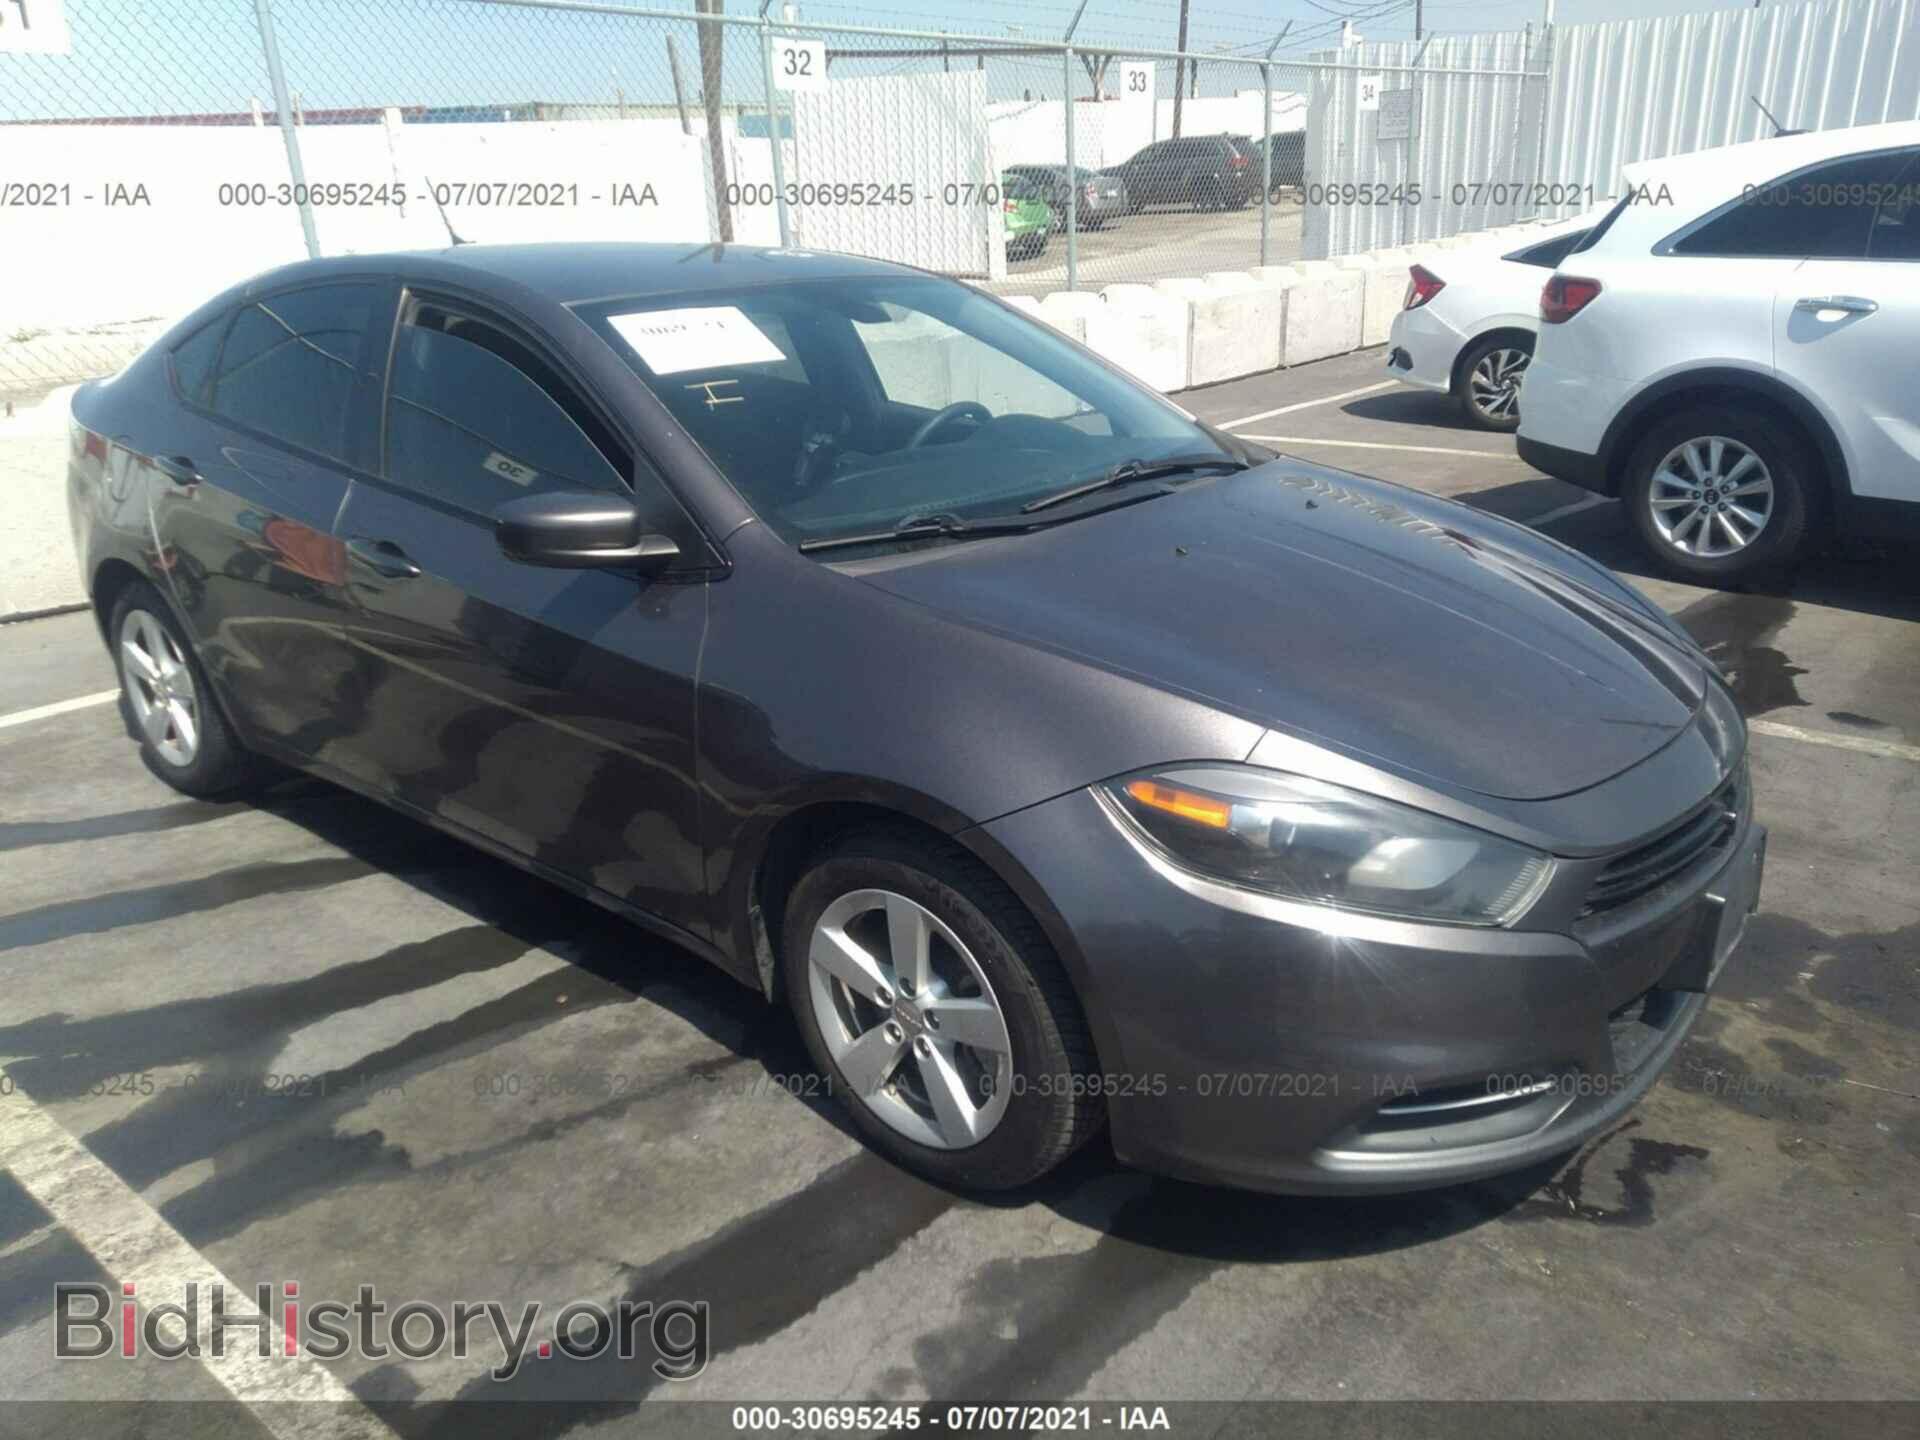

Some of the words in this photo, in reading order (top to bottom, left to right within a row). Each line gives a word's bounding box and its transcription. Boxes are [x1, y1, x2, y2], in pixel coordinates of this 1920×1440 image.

[0, 0, 31, 30] 1
[784, 48, 812, 76] 32
[1129, 70, 1147, 92] 33
[1362, 84, 1374, 102] 34
